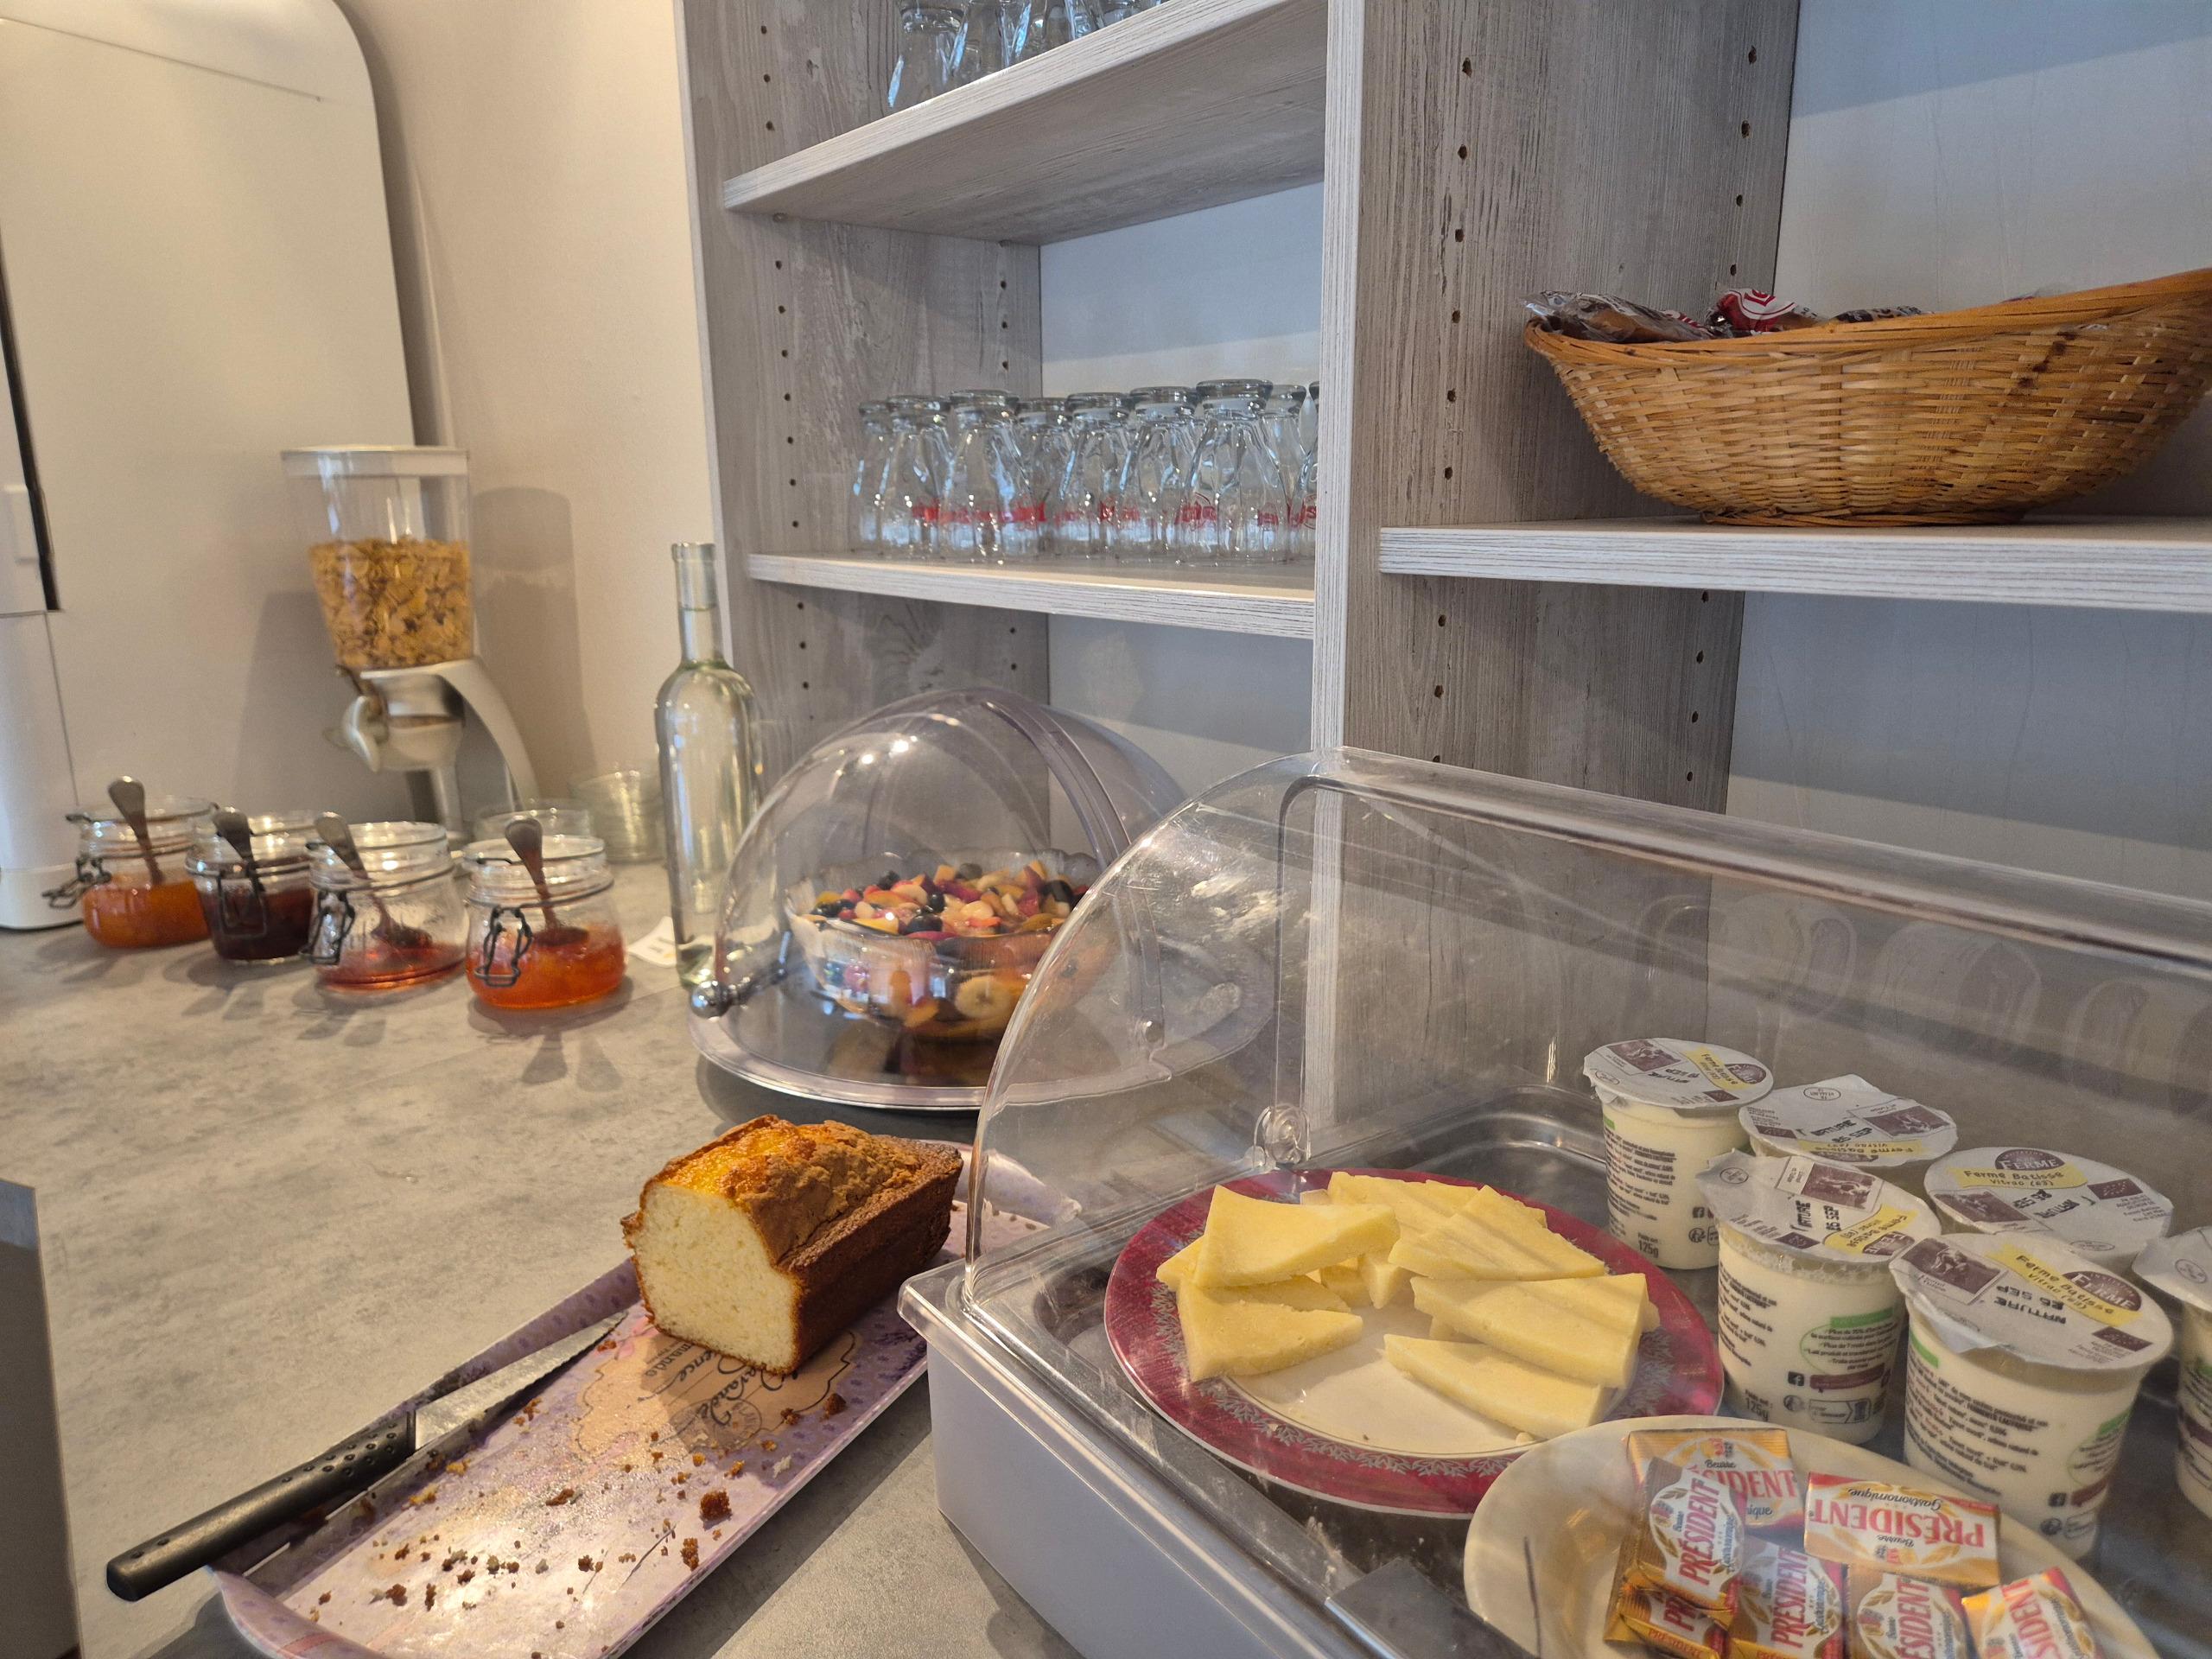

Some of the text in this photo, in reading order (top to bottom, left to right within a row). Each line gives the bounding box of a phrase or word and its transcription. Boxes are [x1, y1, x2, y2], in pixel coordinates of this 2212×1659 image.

[1964, 1170, 2064, 1180] Ferme Batisse
[1998, 1159, 2059, 1170] FERME
[1996, 1284, 2033, 1301] SEP
[2015, 1254, 2115, 1315] Ferme Batisse
[2070, 1272, 2136, 1309] FERME
[1993, 1296, 2067, 1325] NATURE
[1704, 1459, 1736, 1469] Beurre
[1847, 1486, 1943, 1511] Gastronomique
[1679, 1477, 1720, 1586] PRÉSIDENT
[1809, 1499, 1985, 1548] PRÉSIDENT
[1876, 1533, 1916, 1548] Beurre
[1770, 1547, 1808, 1649] PRÉSIDENT
